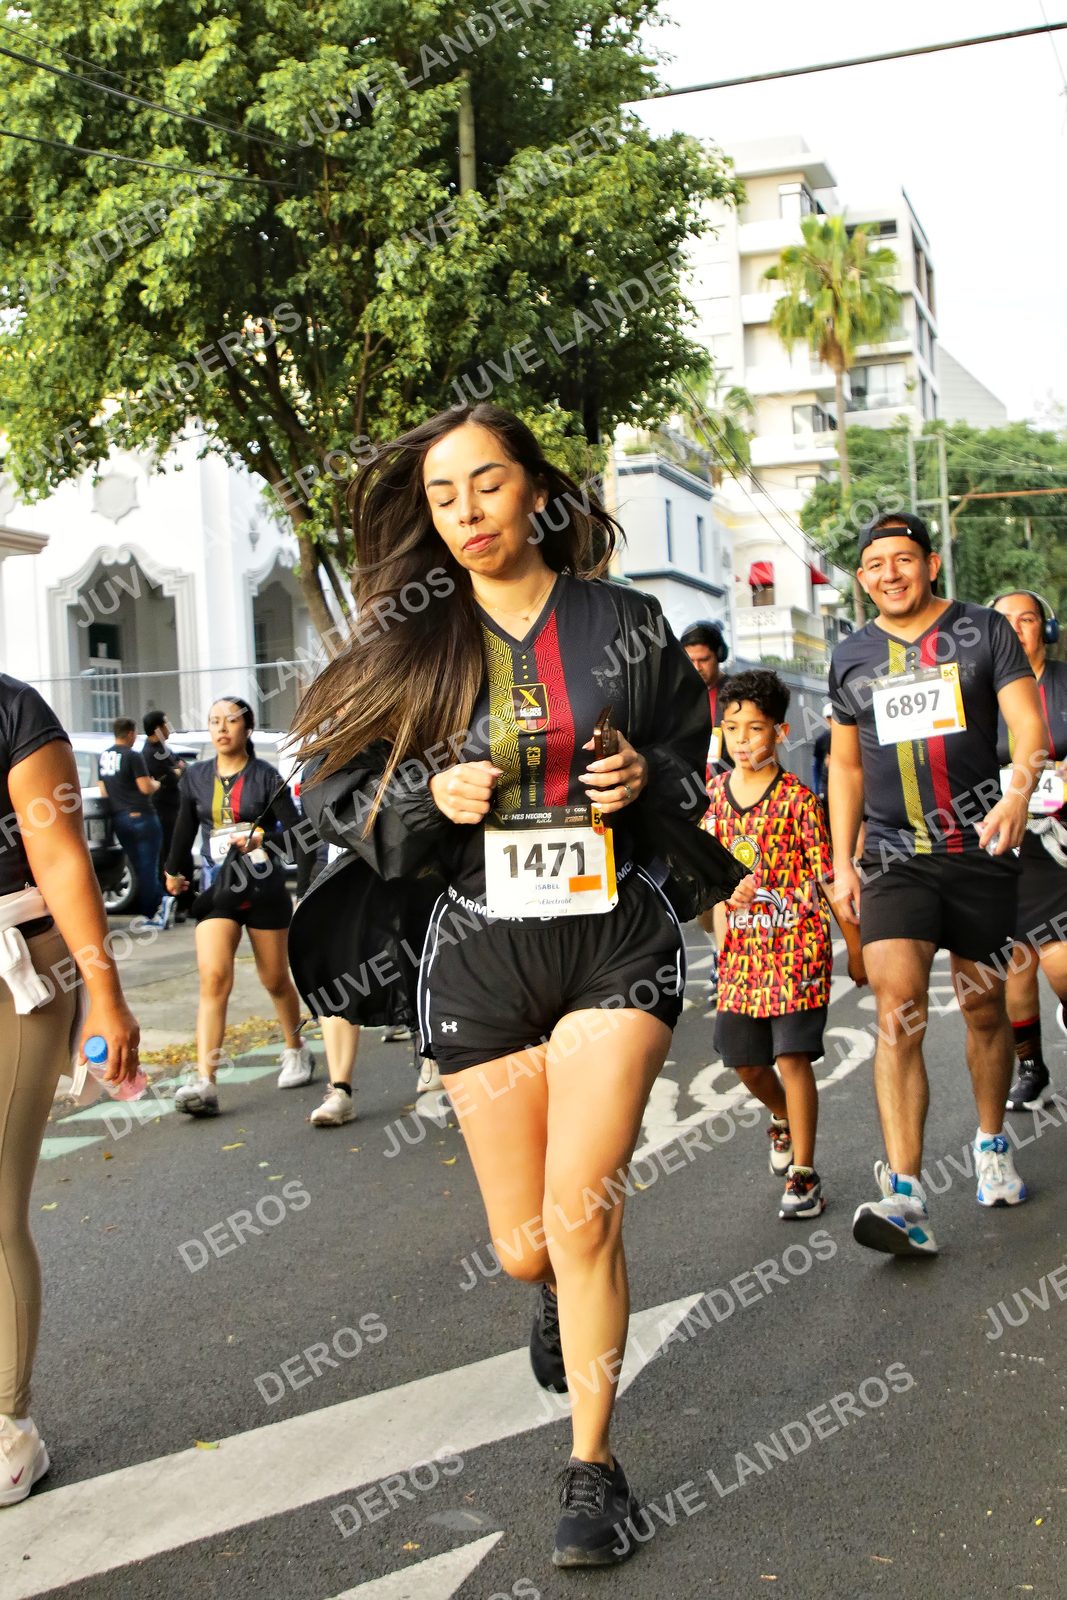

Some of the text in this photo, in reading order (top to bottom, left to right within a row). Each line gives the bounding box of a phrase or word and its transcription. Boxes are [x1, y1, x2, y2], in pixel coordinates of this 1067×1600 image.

[885, 688, 940, 719] 6897
[502, 841, 586, 878] 1471
[535, 883, 560, 891] ISABEL
